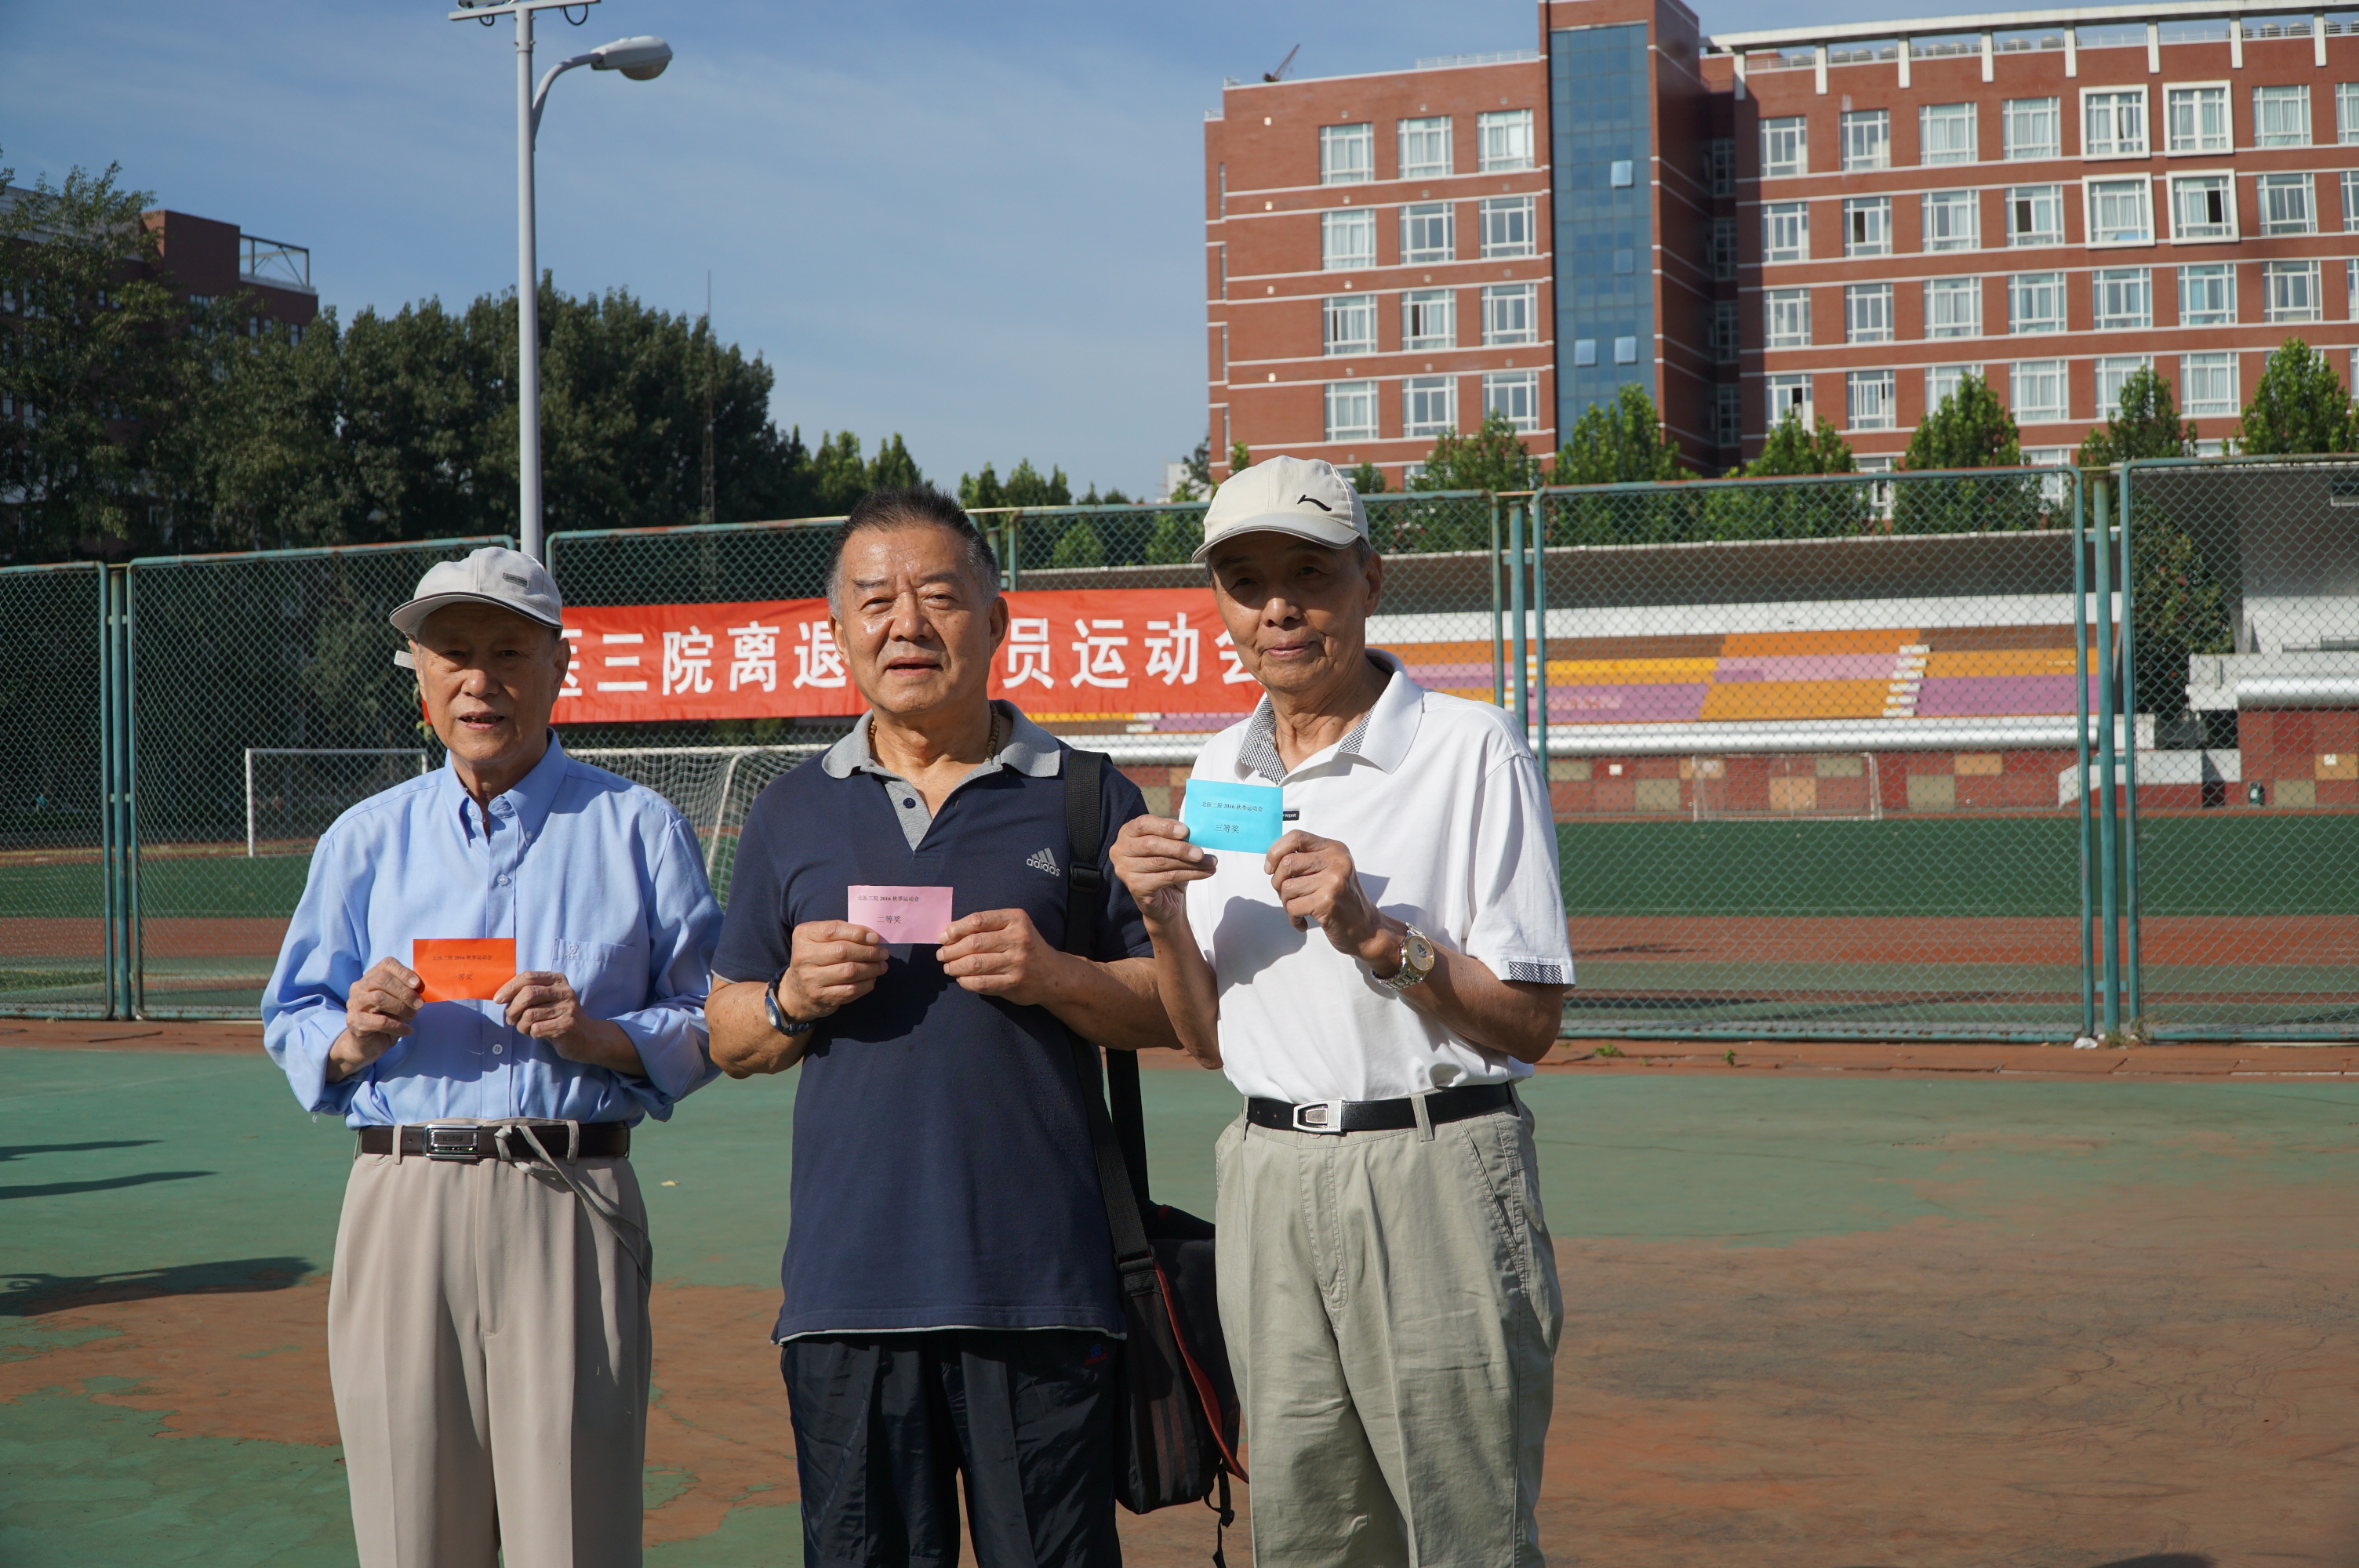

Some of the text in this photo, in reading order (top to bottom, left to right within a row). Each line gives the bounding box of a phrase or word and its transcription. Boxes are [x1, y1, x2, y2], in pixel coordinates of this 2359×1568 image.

[1215, 824, 1240, 833] 三等奖
[1026, 858, 1060, 877] adidas
[877, 916, 902, 924] 二等奖
